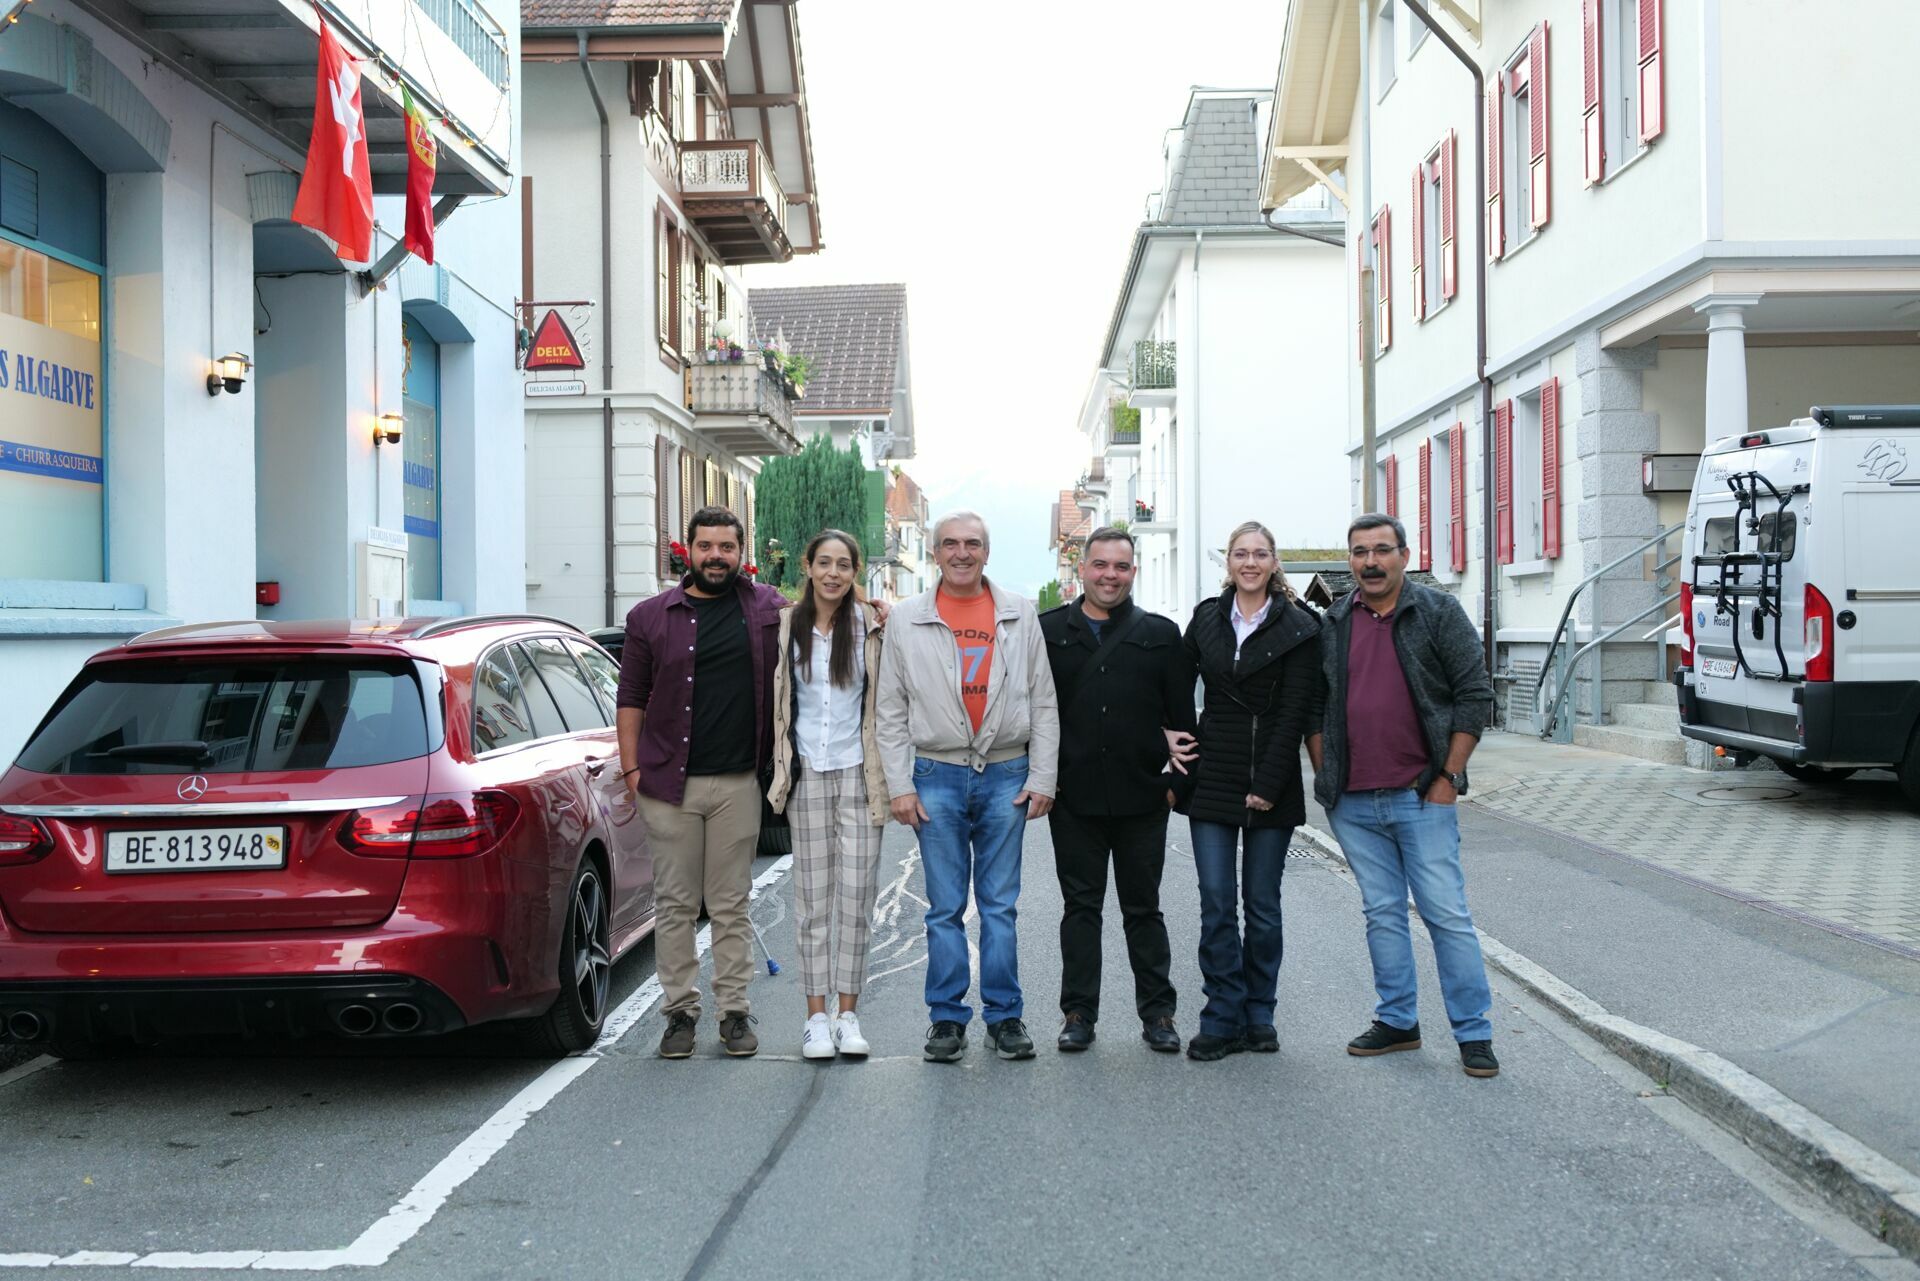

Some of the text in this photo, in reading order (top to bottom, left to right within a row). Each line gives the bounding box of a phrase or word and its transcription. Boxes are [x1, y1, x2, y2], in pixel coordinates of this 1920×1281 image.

[536, 345, 572, 357] DELTA
[14, 353, 95, 410] ALGARVE
[15, 446, 98, 473] CHURRASQUEIRA
[1713, 615, 1731, 627] Road
